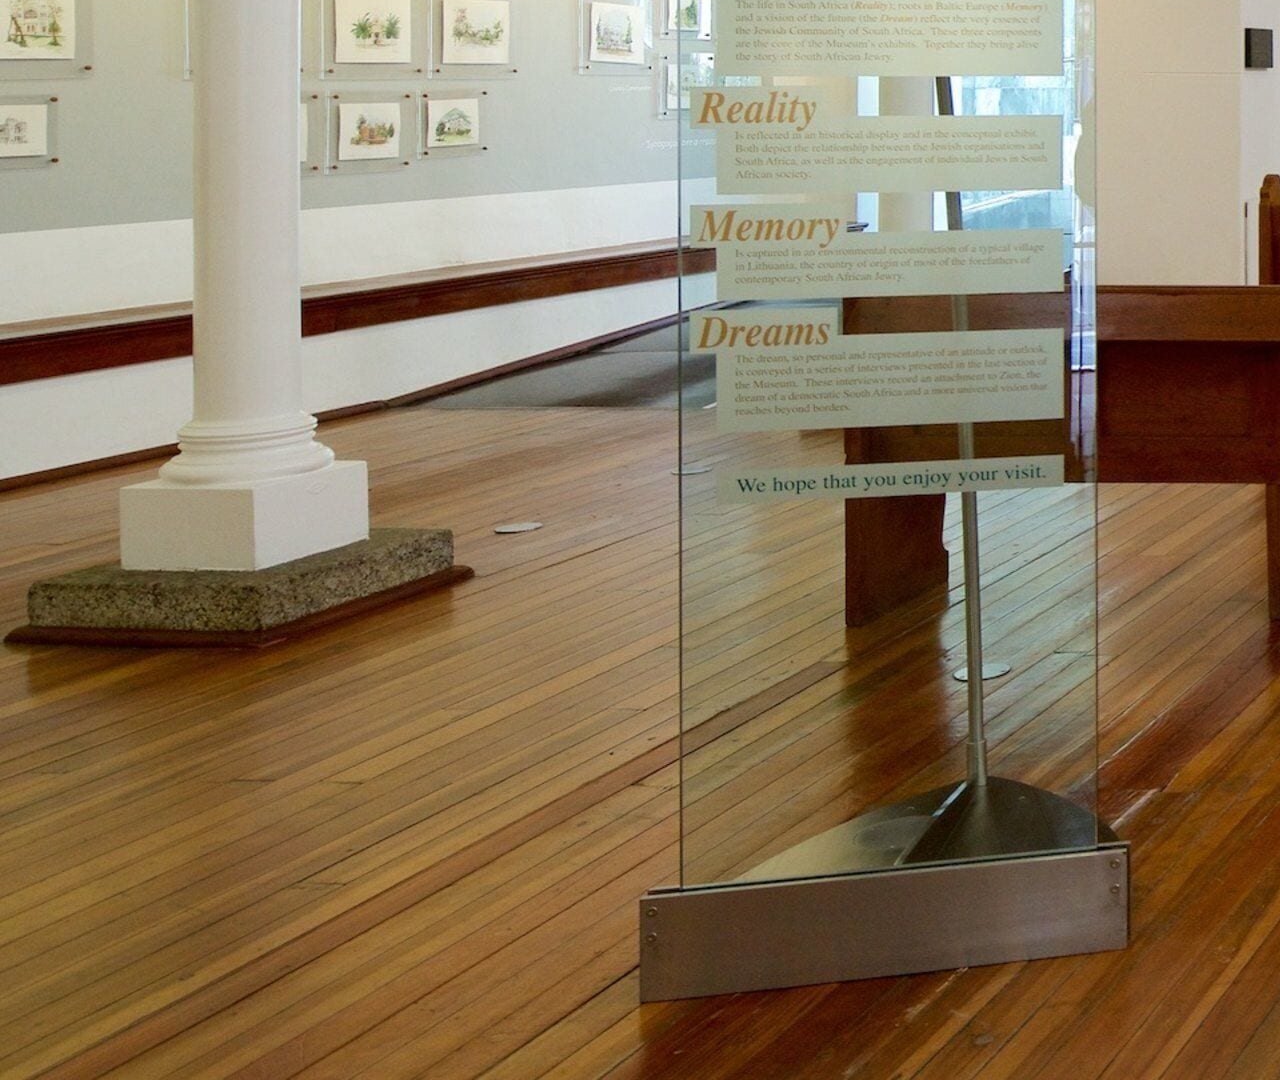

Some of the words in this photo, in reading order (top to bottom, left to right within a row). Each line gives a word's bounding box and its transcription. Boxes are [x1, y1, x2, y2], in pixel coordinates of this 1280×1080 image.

[698, 91, 817, 132] Reality
[697, 209, 840, 249] Memory
[697, 316, 831, 349] Dreams
[737, 477, 766, 493] We
[773, 476, 816, 495] hope
[823, 473, 857, 490] that
[863, 475, 897, 491] you
[902, 471, 951, 491] enjoy
[958, 470, 999, 489] your
[1004, 463, 1047, 481] visit.
